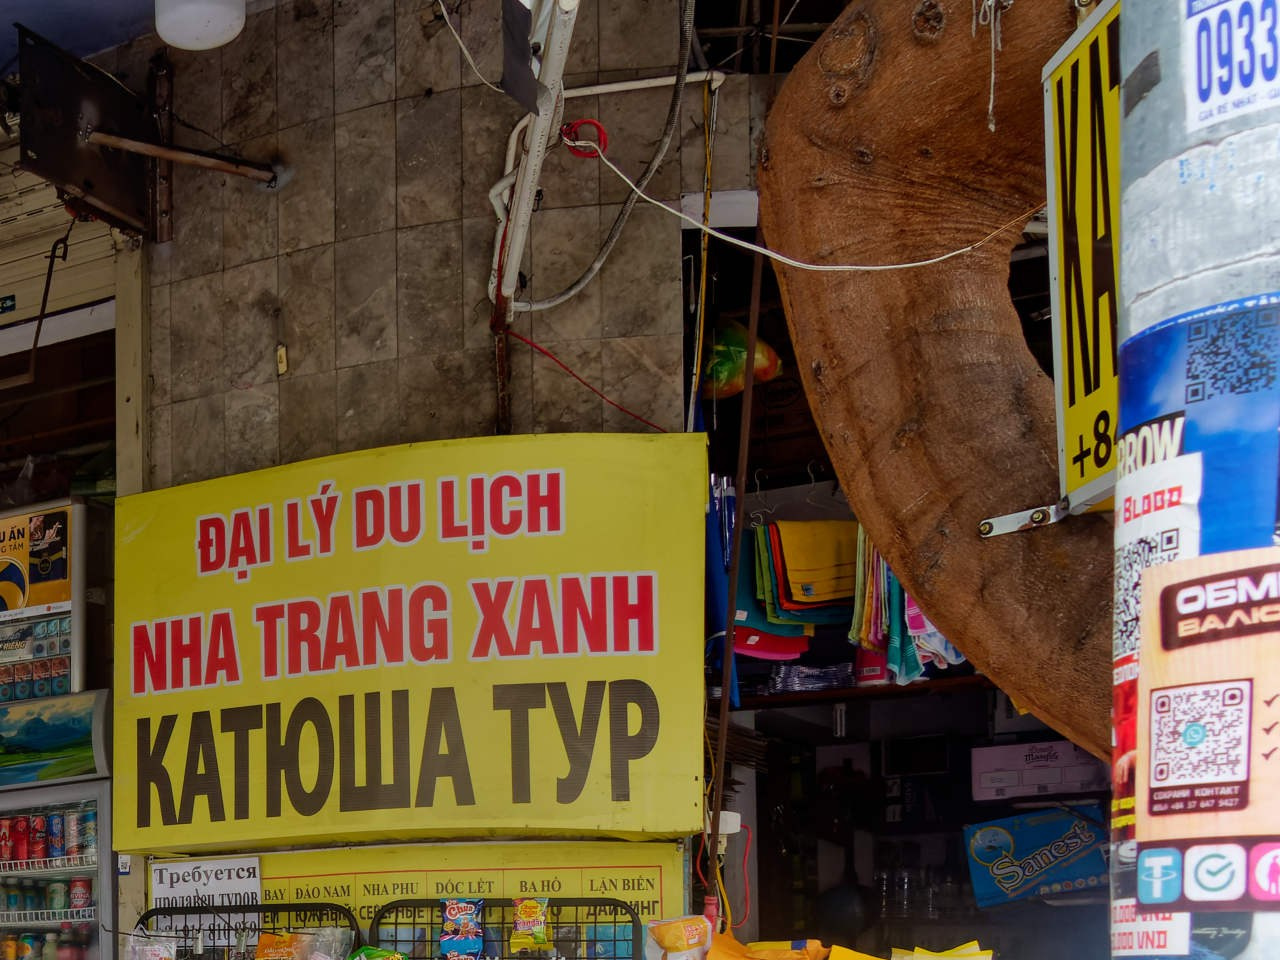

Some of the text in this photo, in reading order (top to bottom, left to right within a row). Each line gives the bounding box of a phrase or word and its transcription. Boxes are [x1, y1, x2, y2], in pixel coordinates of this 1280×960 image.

[1073, 410, 1118, 478] +8
[198, 470, 561, 580] ĐẠI LÝ DU LỊCH
[133, 574, 654, 694] NHA TRANG XANH
[136, 679, 660, 828] КАТЮША ТУР
[1194, 785, 1240, 797] КОНТАКТ
[154, 865, 257, 888] Требуется
[264, 888, 287, 901] BAY
[323, 885, 351, 899] NAM
[363, 882, 390, 896] NHA
[393, 881, 419, 895] PHU
[519, 880, 540, 893] BA
[991, 822, 1096, 894] Sanest
